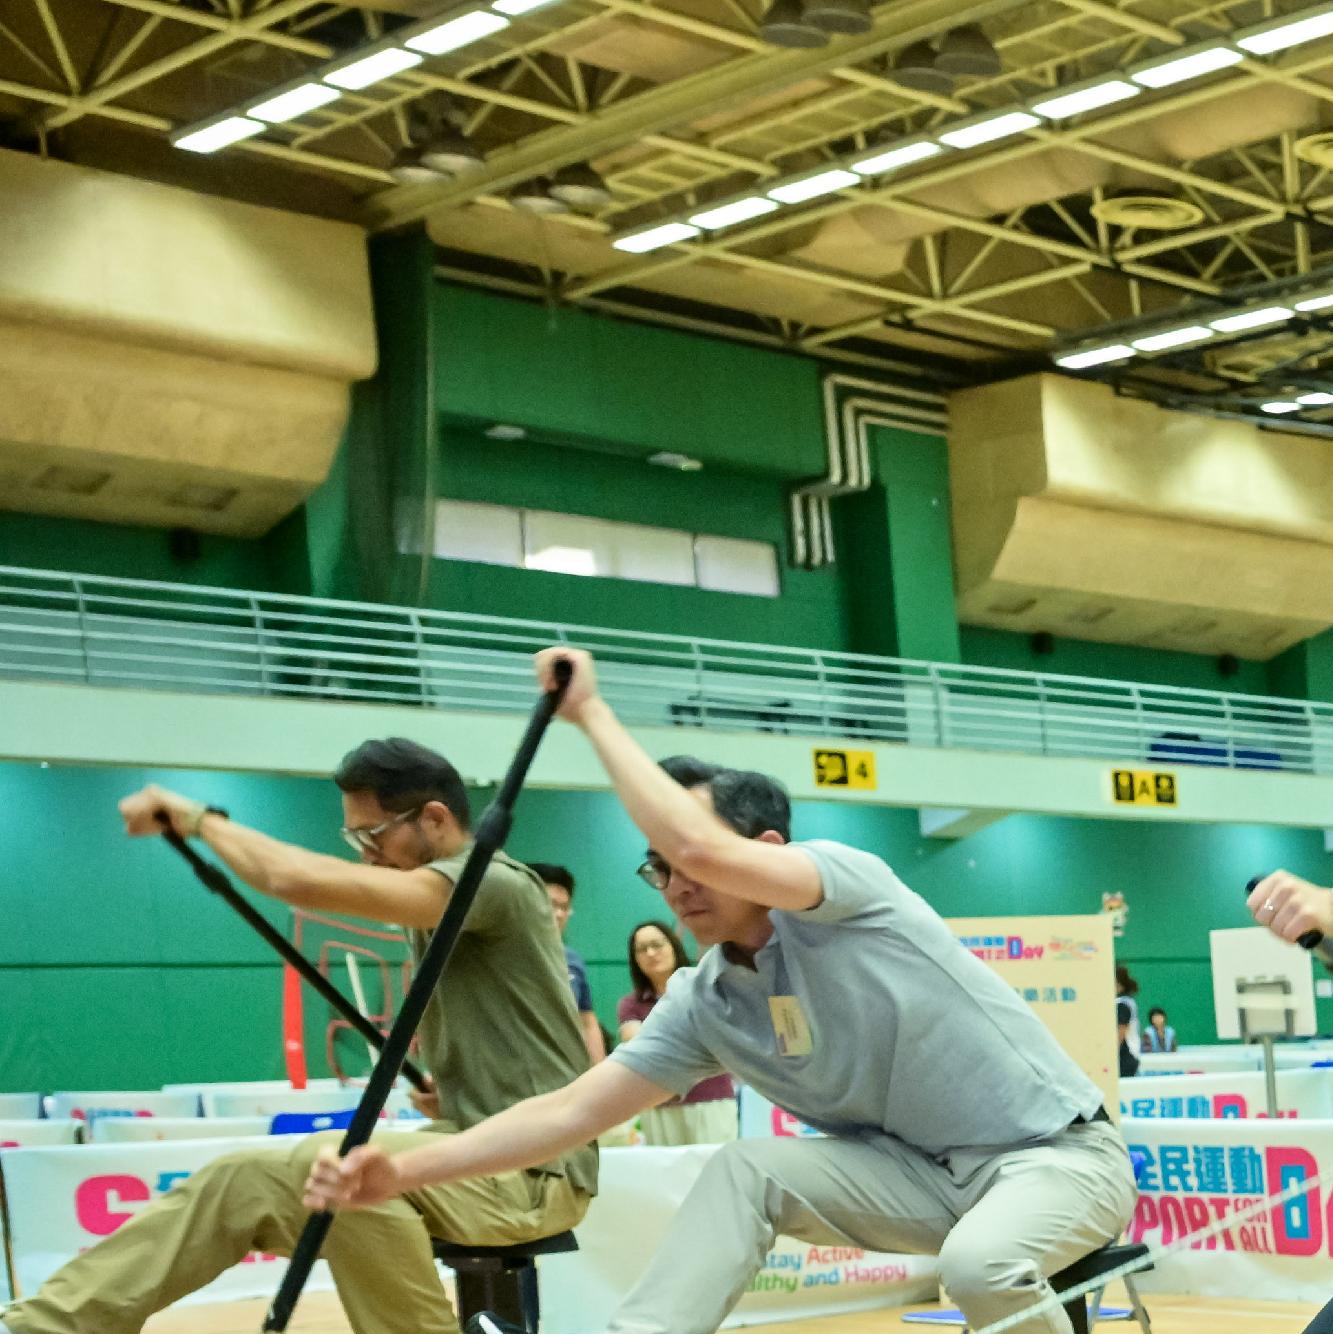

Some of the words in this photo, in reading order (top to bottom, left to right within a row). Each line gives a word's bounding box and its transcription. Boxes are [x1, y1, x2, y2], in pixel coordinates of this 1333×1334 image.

[854, 763, 869, 781] 4
[1137, 781, 1151, 798] A
[1126, 1195, 1236, 1250] PORT
[765, 1252, 802, 1271] tay
[803, 1268, 840, 1288] and
[844, 1264, 907, 1285] Happy
